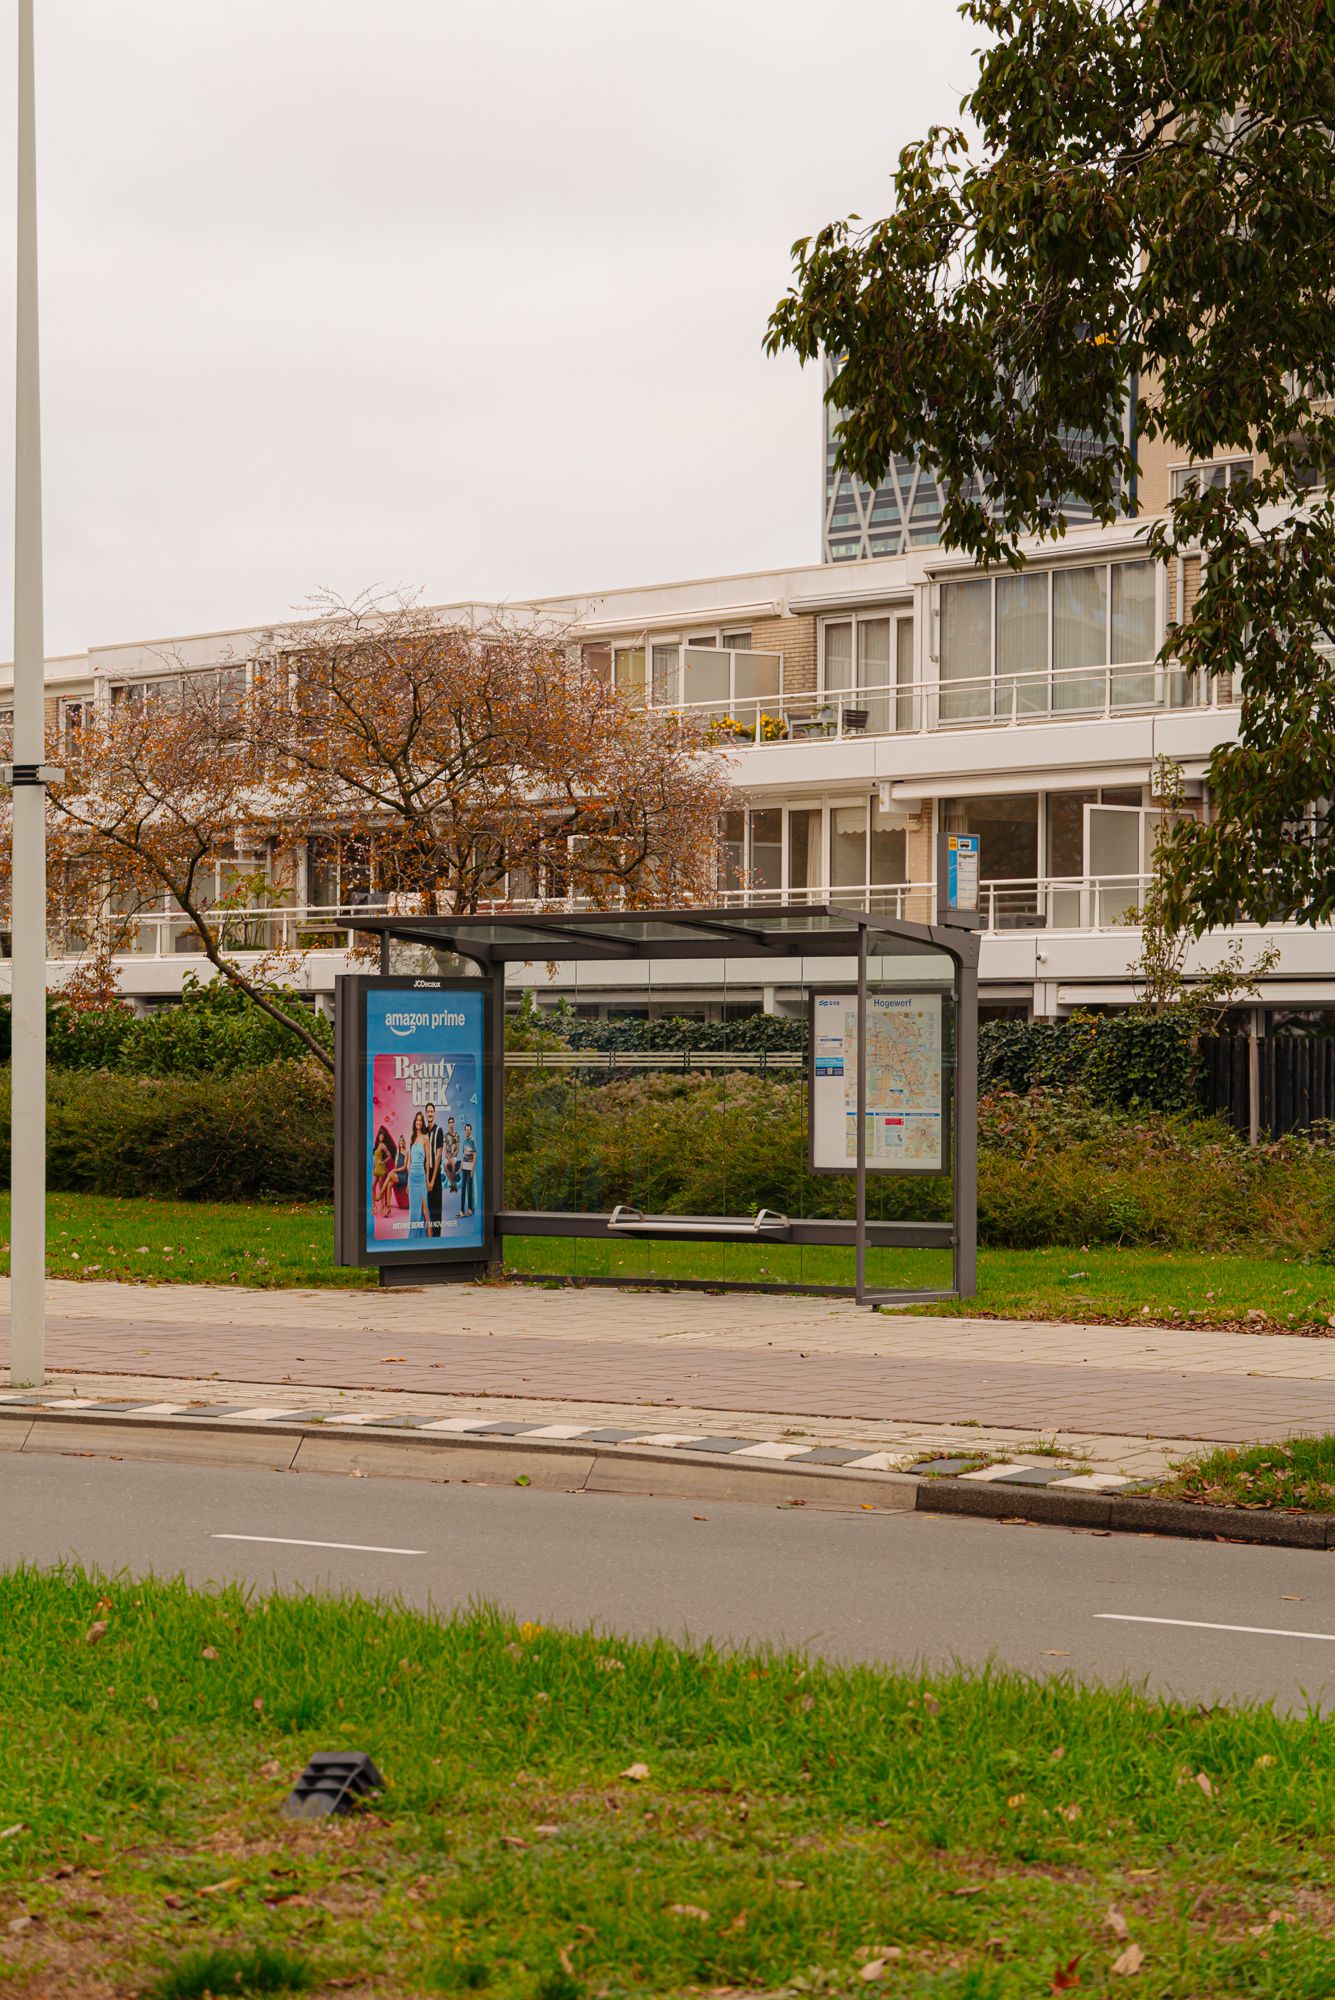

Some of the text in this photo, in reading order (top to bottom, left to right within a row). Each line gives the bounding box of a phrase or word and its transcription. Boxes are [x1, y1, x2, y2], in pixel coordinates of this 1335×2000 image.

[413, 980, 441, 988] JCDecaux
[873, 999, 912, 1009] Hogewerf
[385, 1009, 466, 1030] amazon prime
[393, 1055, 456, 1083] Beauty
[412, 1078, 449, 1106] GEEK
